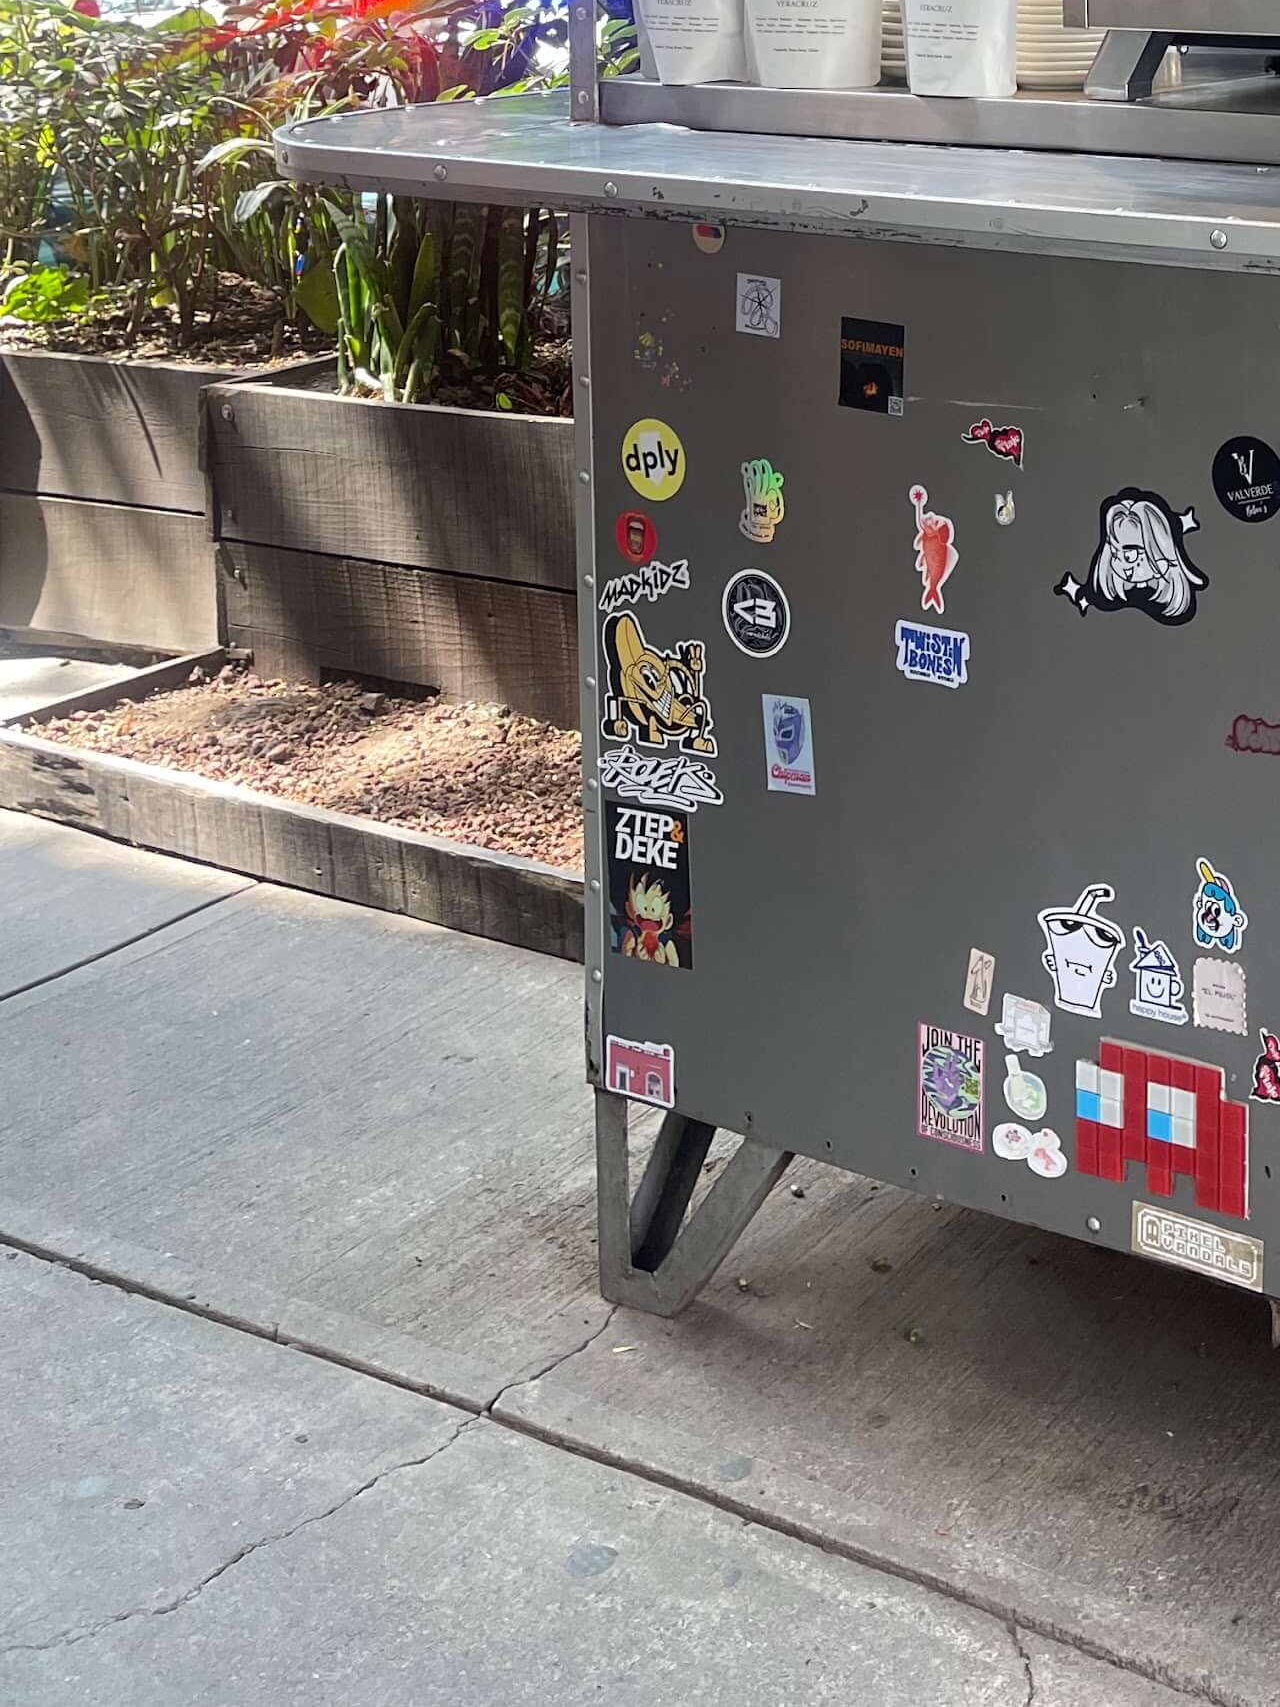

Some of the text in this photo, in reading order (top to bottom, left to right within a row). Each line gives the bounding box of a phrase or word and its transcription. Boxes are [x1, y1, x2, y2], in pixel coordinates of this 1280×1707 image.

[776, 0, 818, 9] VERACRUZ
[626, 441, 679, 478] dply
[1227, 484, 1274, 501] VALVERDE
[602, 563, 687, 609] MADKIDZ
[910, 651, 954, 677] BONES
[615, 807, 673, 840] ZTEP
[615, 832, 679, 871] DEKE
[922, 1026, 982, 1071] JOIN THE
[921, 1095, 982, 1140] REVOLUTION
[1162, 1220, 1227, 1254] PIXEL
[1160, 1237, 1252, 1276] VANDALS
